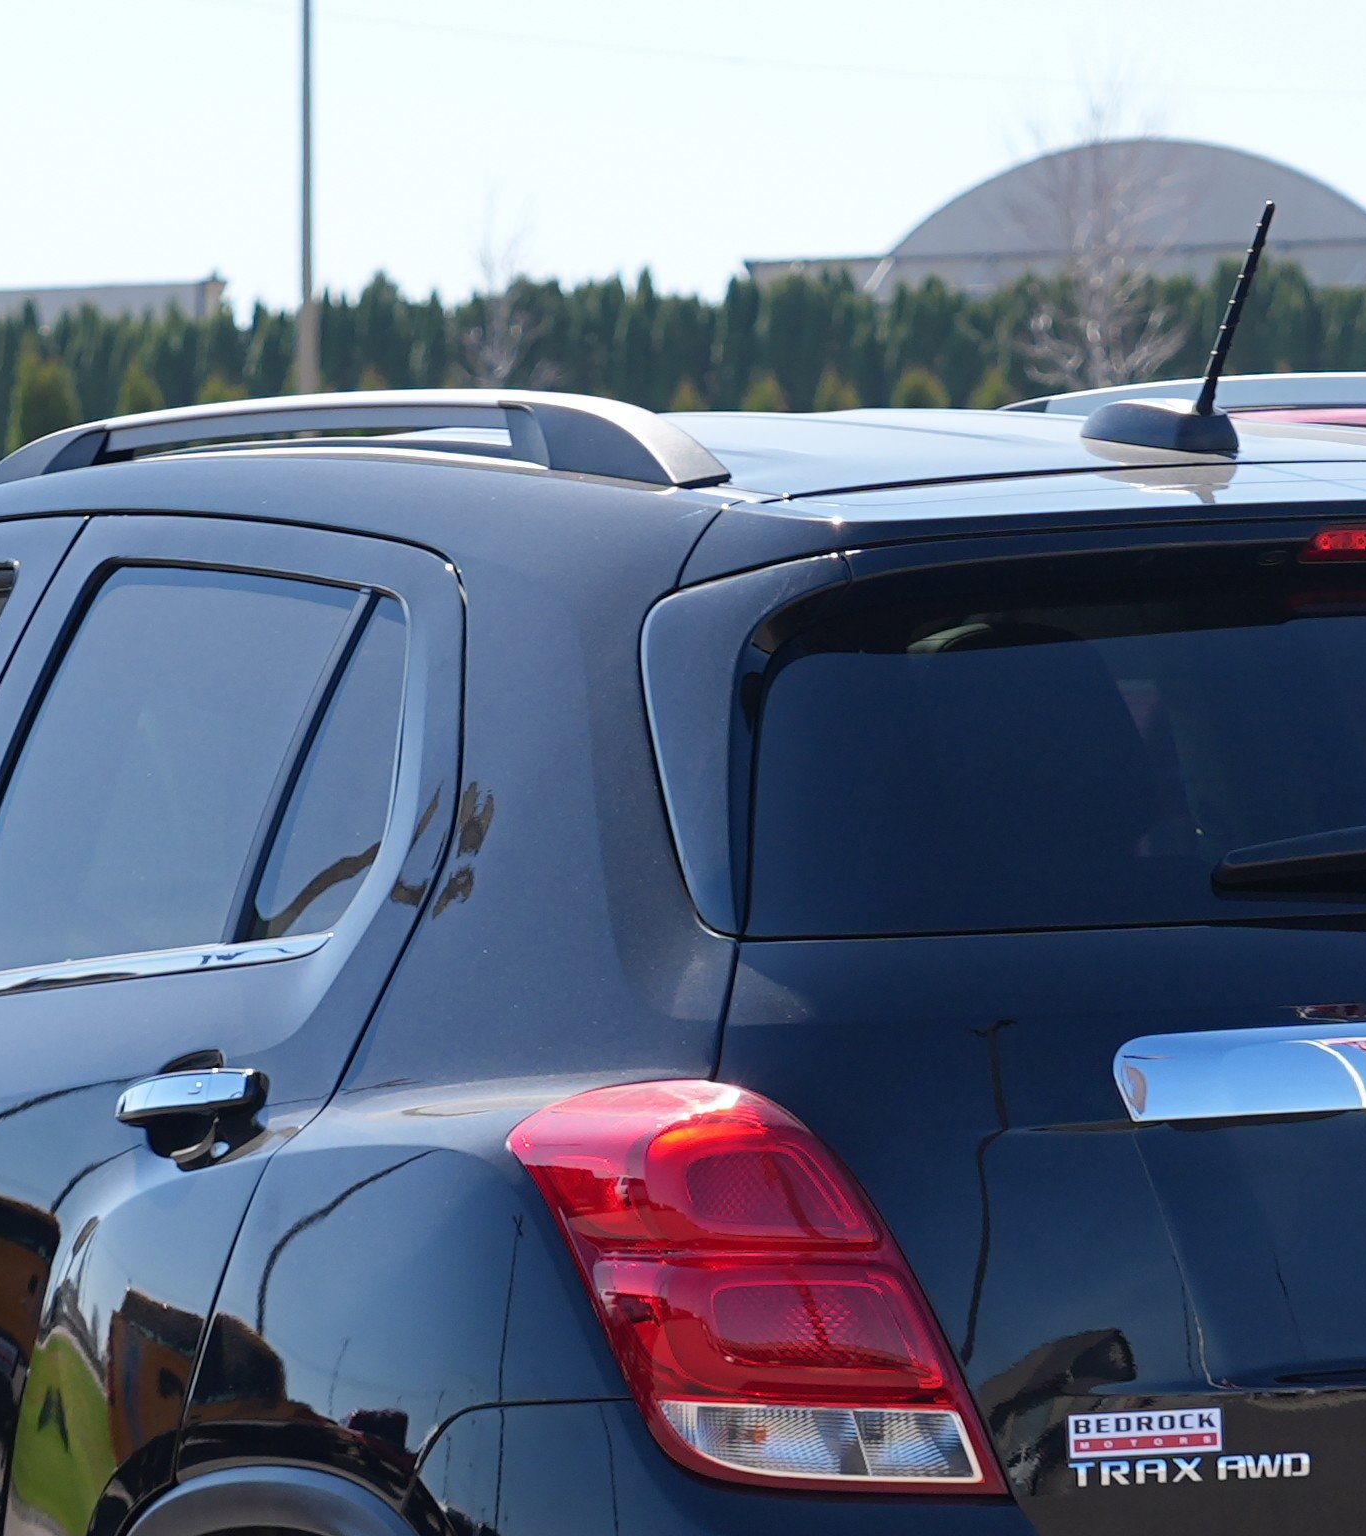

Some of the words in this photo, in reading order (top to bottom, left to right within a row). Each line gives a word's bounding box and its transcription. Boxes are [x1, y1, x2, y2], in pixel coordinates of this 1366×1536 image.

[1073, 1412, 1216, 1435] BEDROCK
[1079, 1434, 1213, 1450] MOTORS
[1068, 1456, 1203, 1487] TRAX
[1217, 1452, 1311, 1481] AWD
